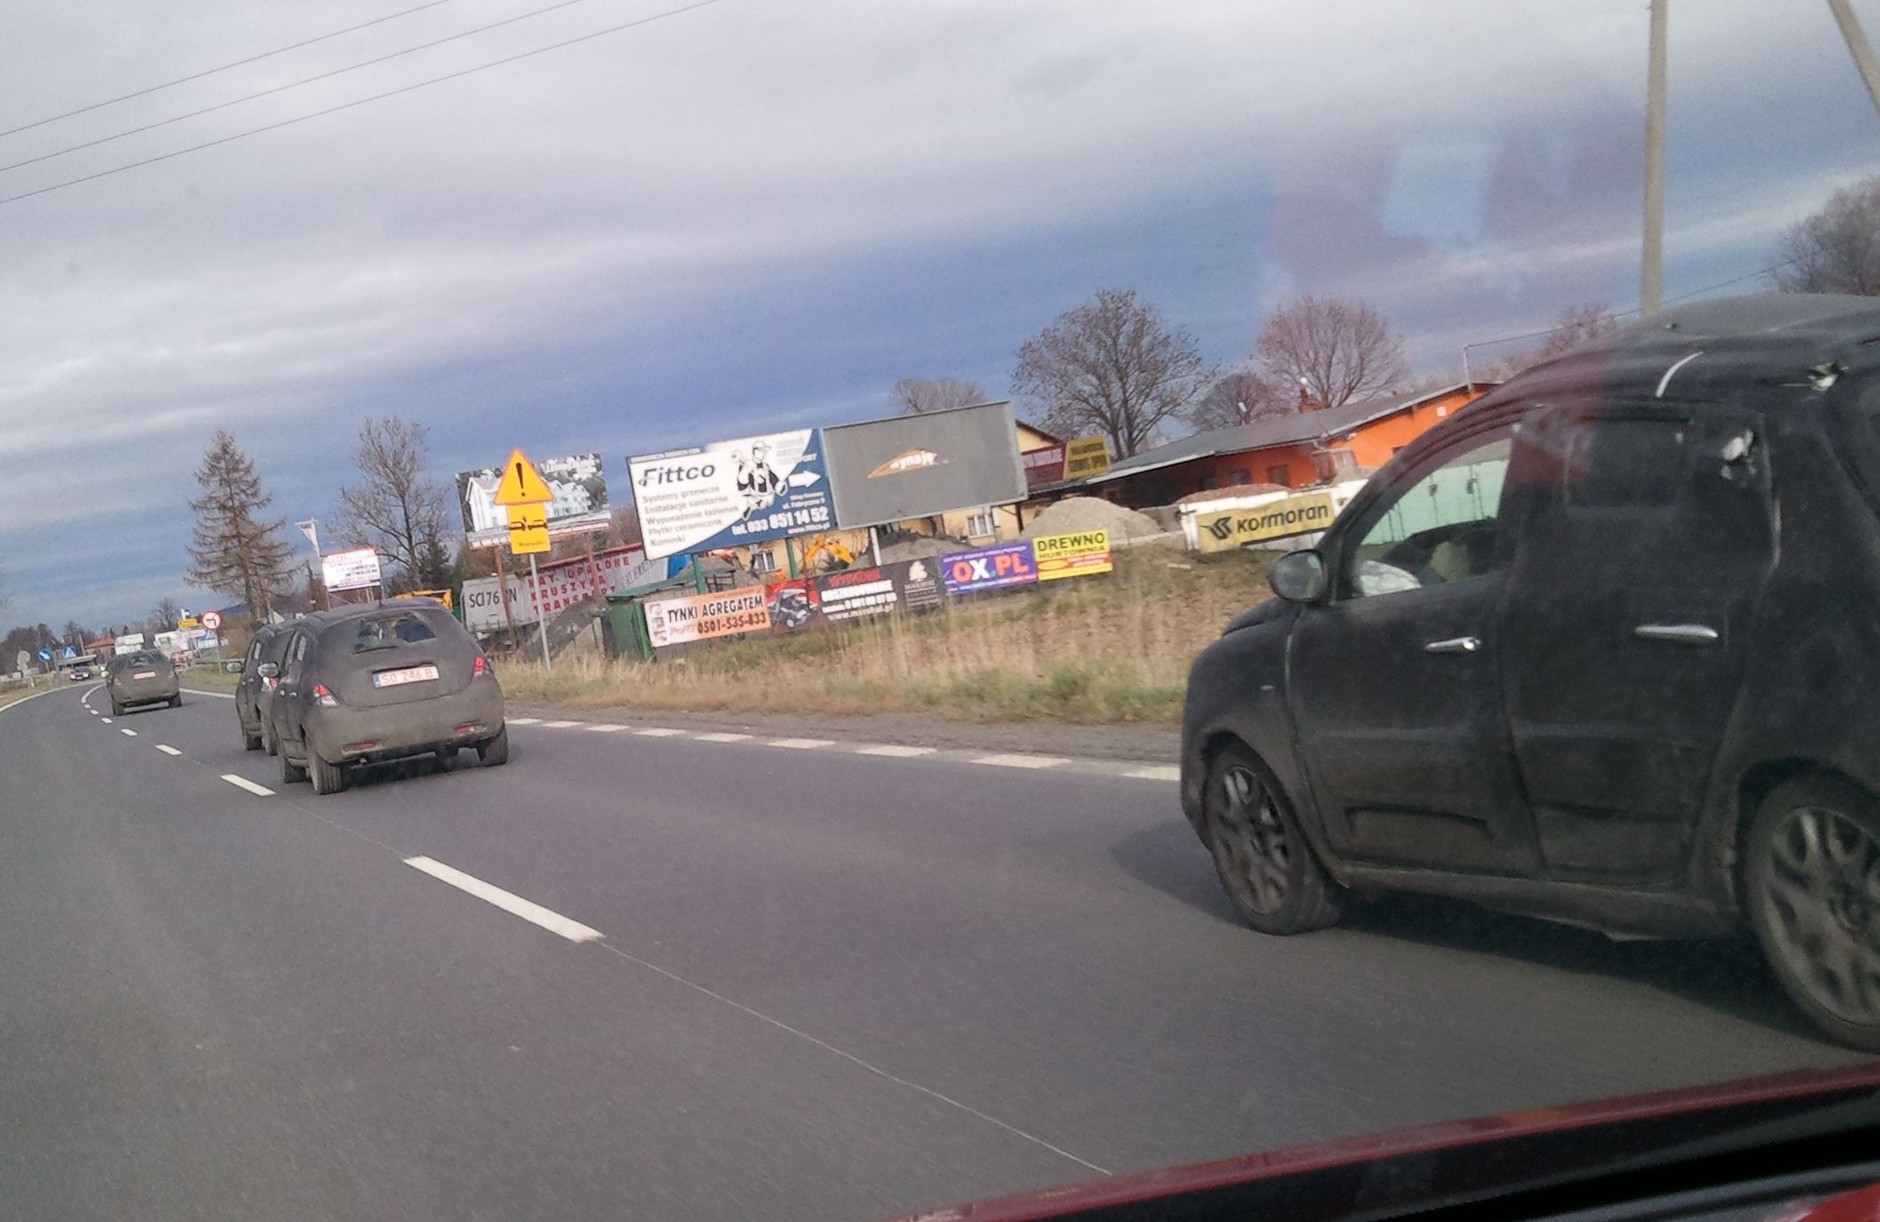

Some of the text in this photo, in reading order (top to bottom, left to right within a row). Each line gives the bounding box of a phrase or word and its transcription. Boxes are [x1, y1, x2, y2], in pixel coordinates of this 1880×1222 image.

[638, 464, 716, 488] Fittco
[642, 493, 679, 504] Systemy
[645, 496, 728, 514] Instalacje sanitarne
[768, 511, 794, 530] 851
[794, 508, 811, 525] 14
[810, 506, 830, 523] 52
[1037, 532, 1105, 552] DREWNO
[668, 595, 763, 623] TYNKI AGREGATEM
[697, 612, 767, 634] 0501-535-833
